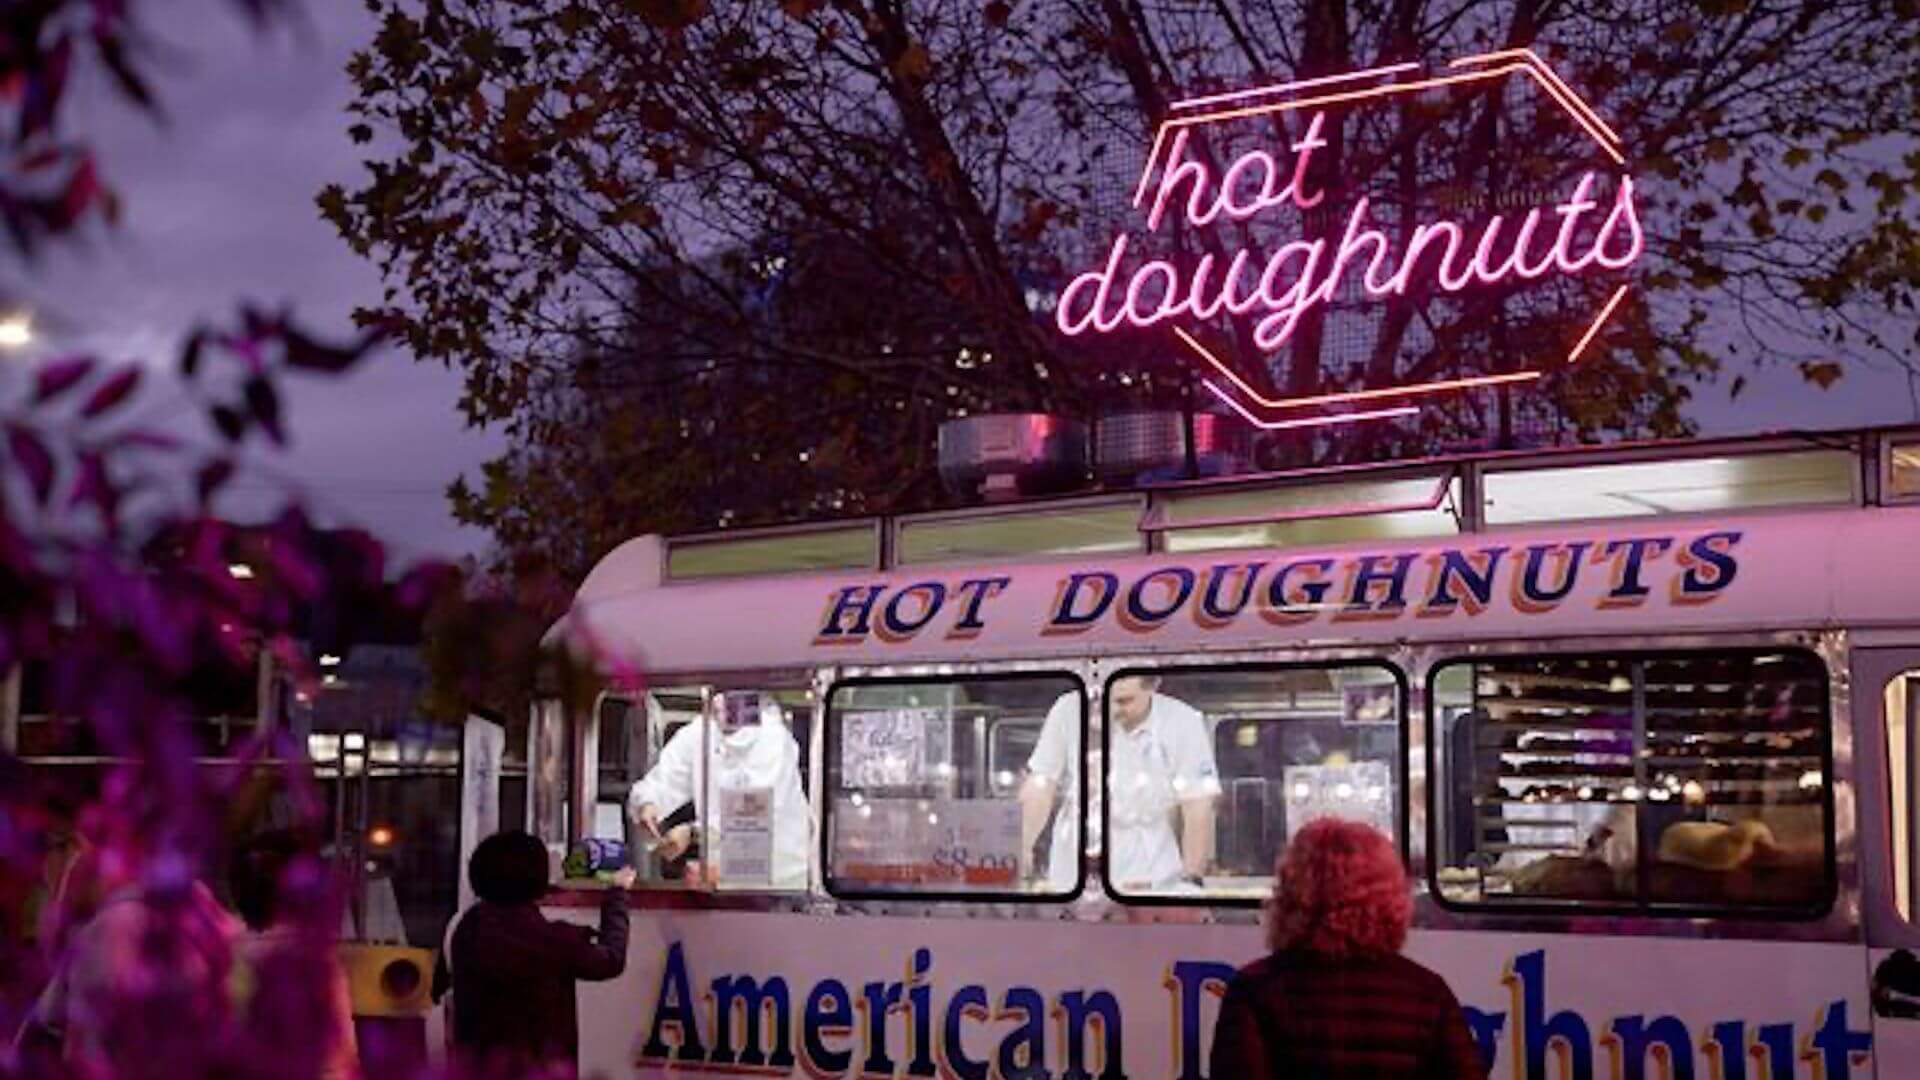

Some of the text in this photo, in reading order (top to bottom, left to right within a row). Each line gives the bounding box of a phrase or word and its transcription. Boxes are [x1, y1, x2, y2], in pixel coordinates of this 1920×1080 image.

[1147, 111, 1326, 231] hot
[1057, 172, 1644, 350] doughnuts
[812, 531, 1743, 646] HOT DOUGHNUTS
[637, 940, 1128, 1080] American
